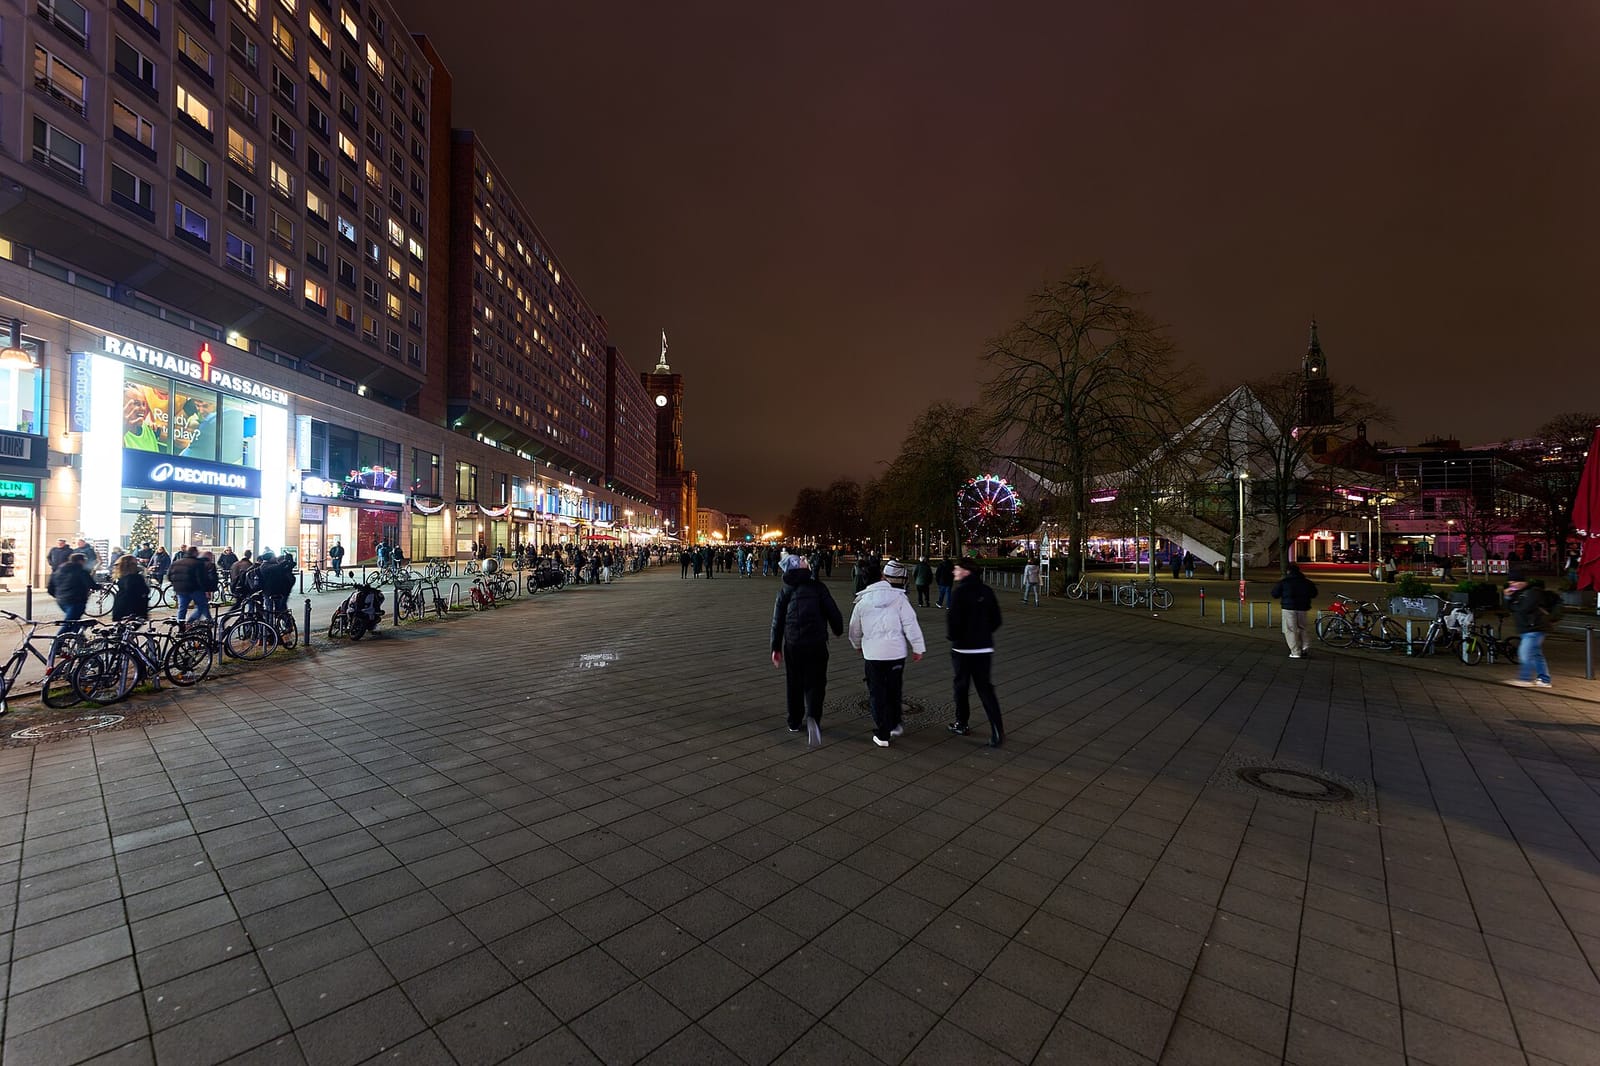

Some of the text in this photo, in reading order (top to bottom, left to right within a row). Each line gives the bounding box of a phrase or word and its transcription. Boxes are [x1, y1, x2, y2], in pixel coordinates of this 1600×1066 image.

[105, 336, 288, 405] RATHAUS PASSAGEN
[174, 427, 201, 443] play?
[173, 467, 246, 488] DECATHLON
